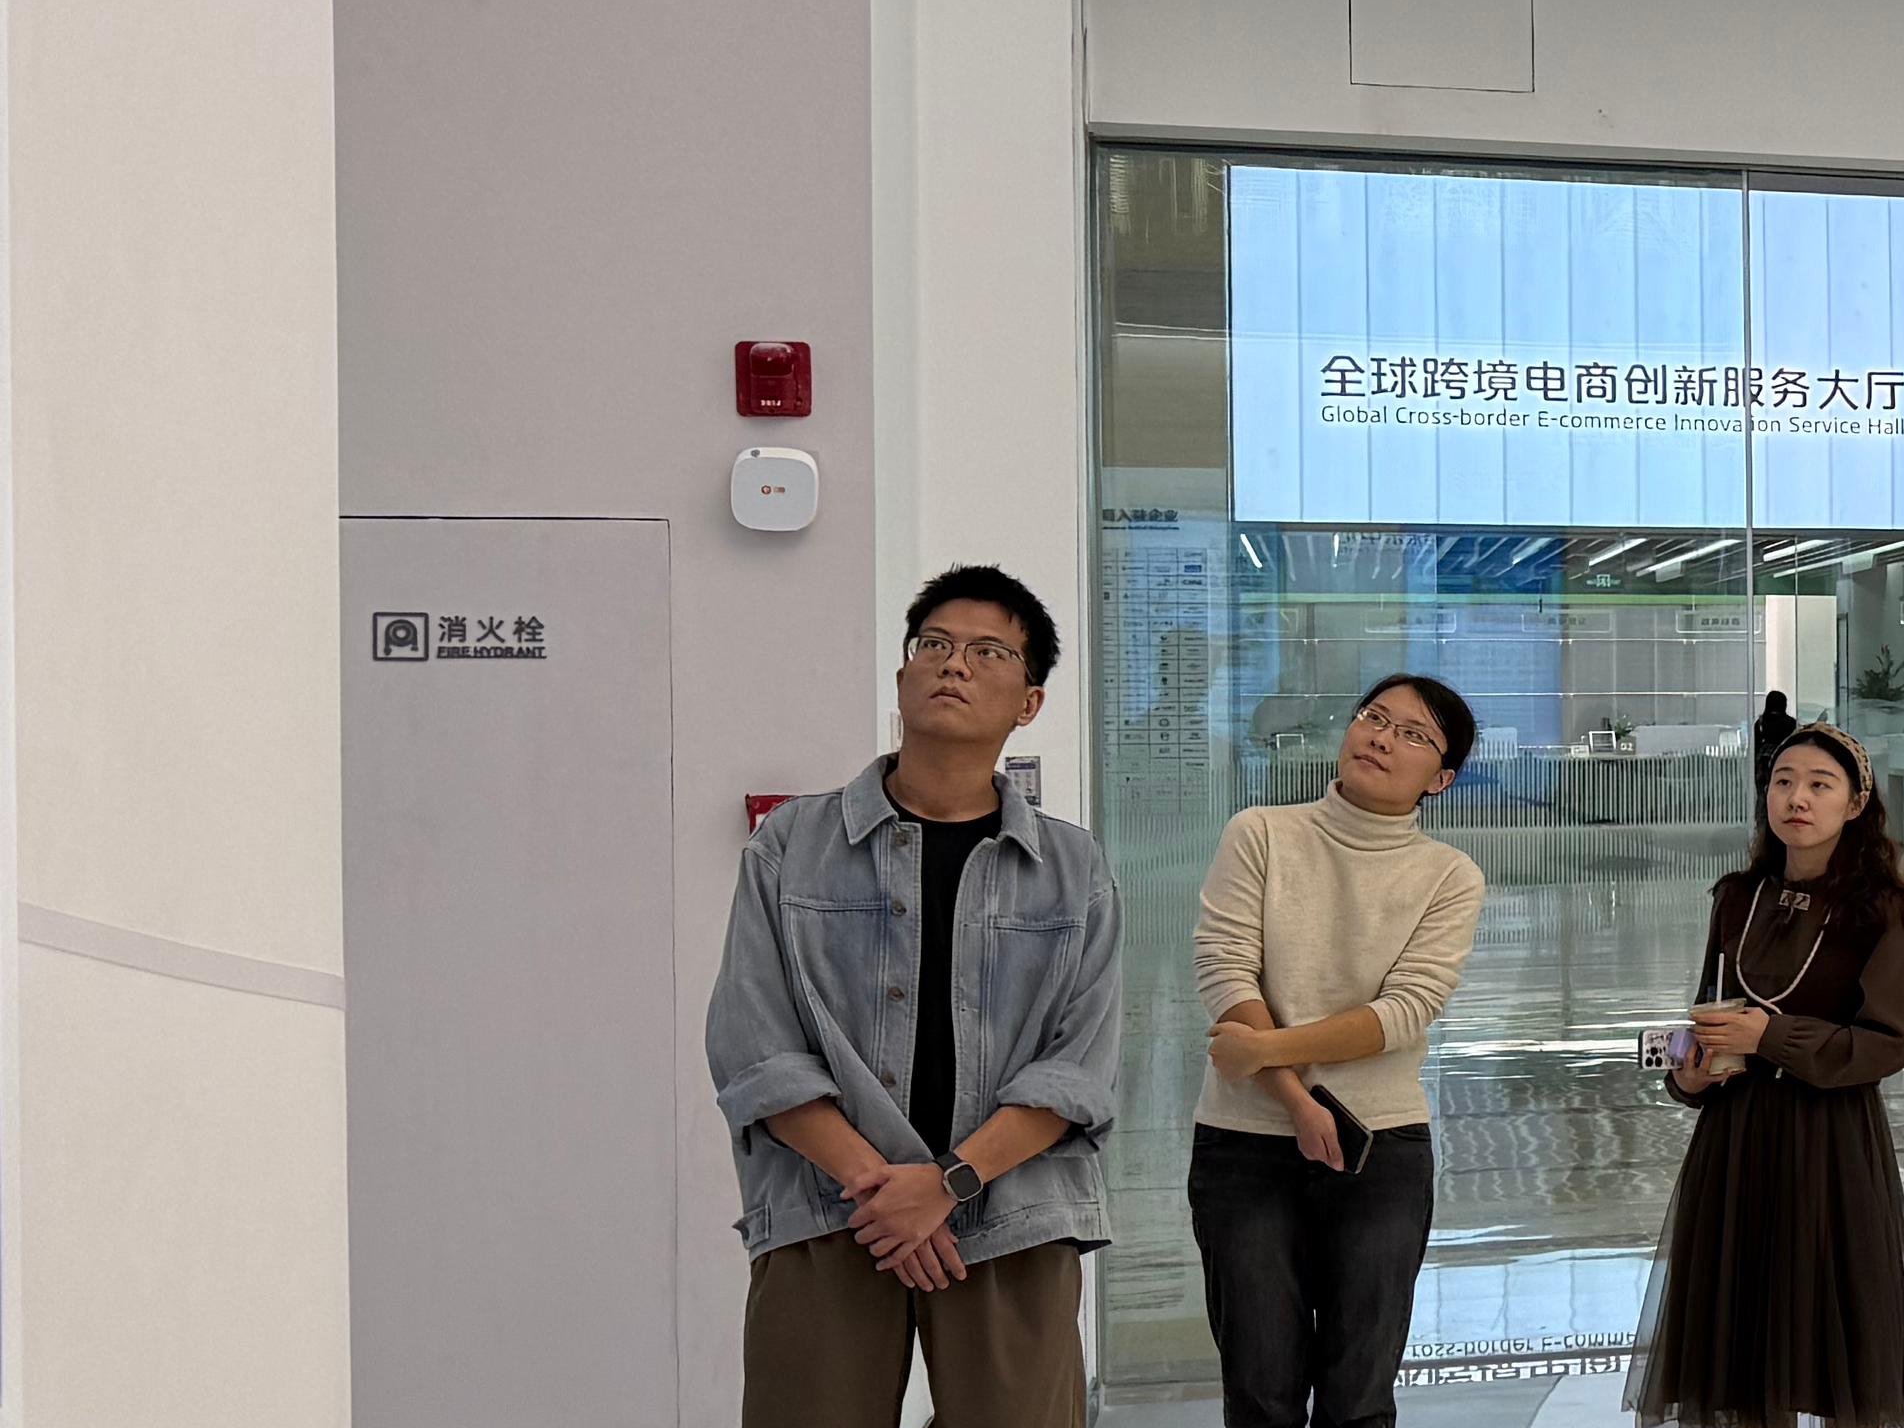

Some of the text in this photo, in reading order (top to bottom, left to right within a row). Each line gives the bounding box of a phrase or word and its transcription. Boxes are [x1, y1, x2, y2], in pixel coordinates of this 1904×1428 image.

[1320, 355, 1904, 410] 全球跨境电商创新服务大厅
[1321, 405, 1904, 435] Global Cross-border E-commerce Innovaion Service Hall
[438, 615, 545, 644] 消火栓
[436, 646, 547, 659] FIRE HYDRANT
